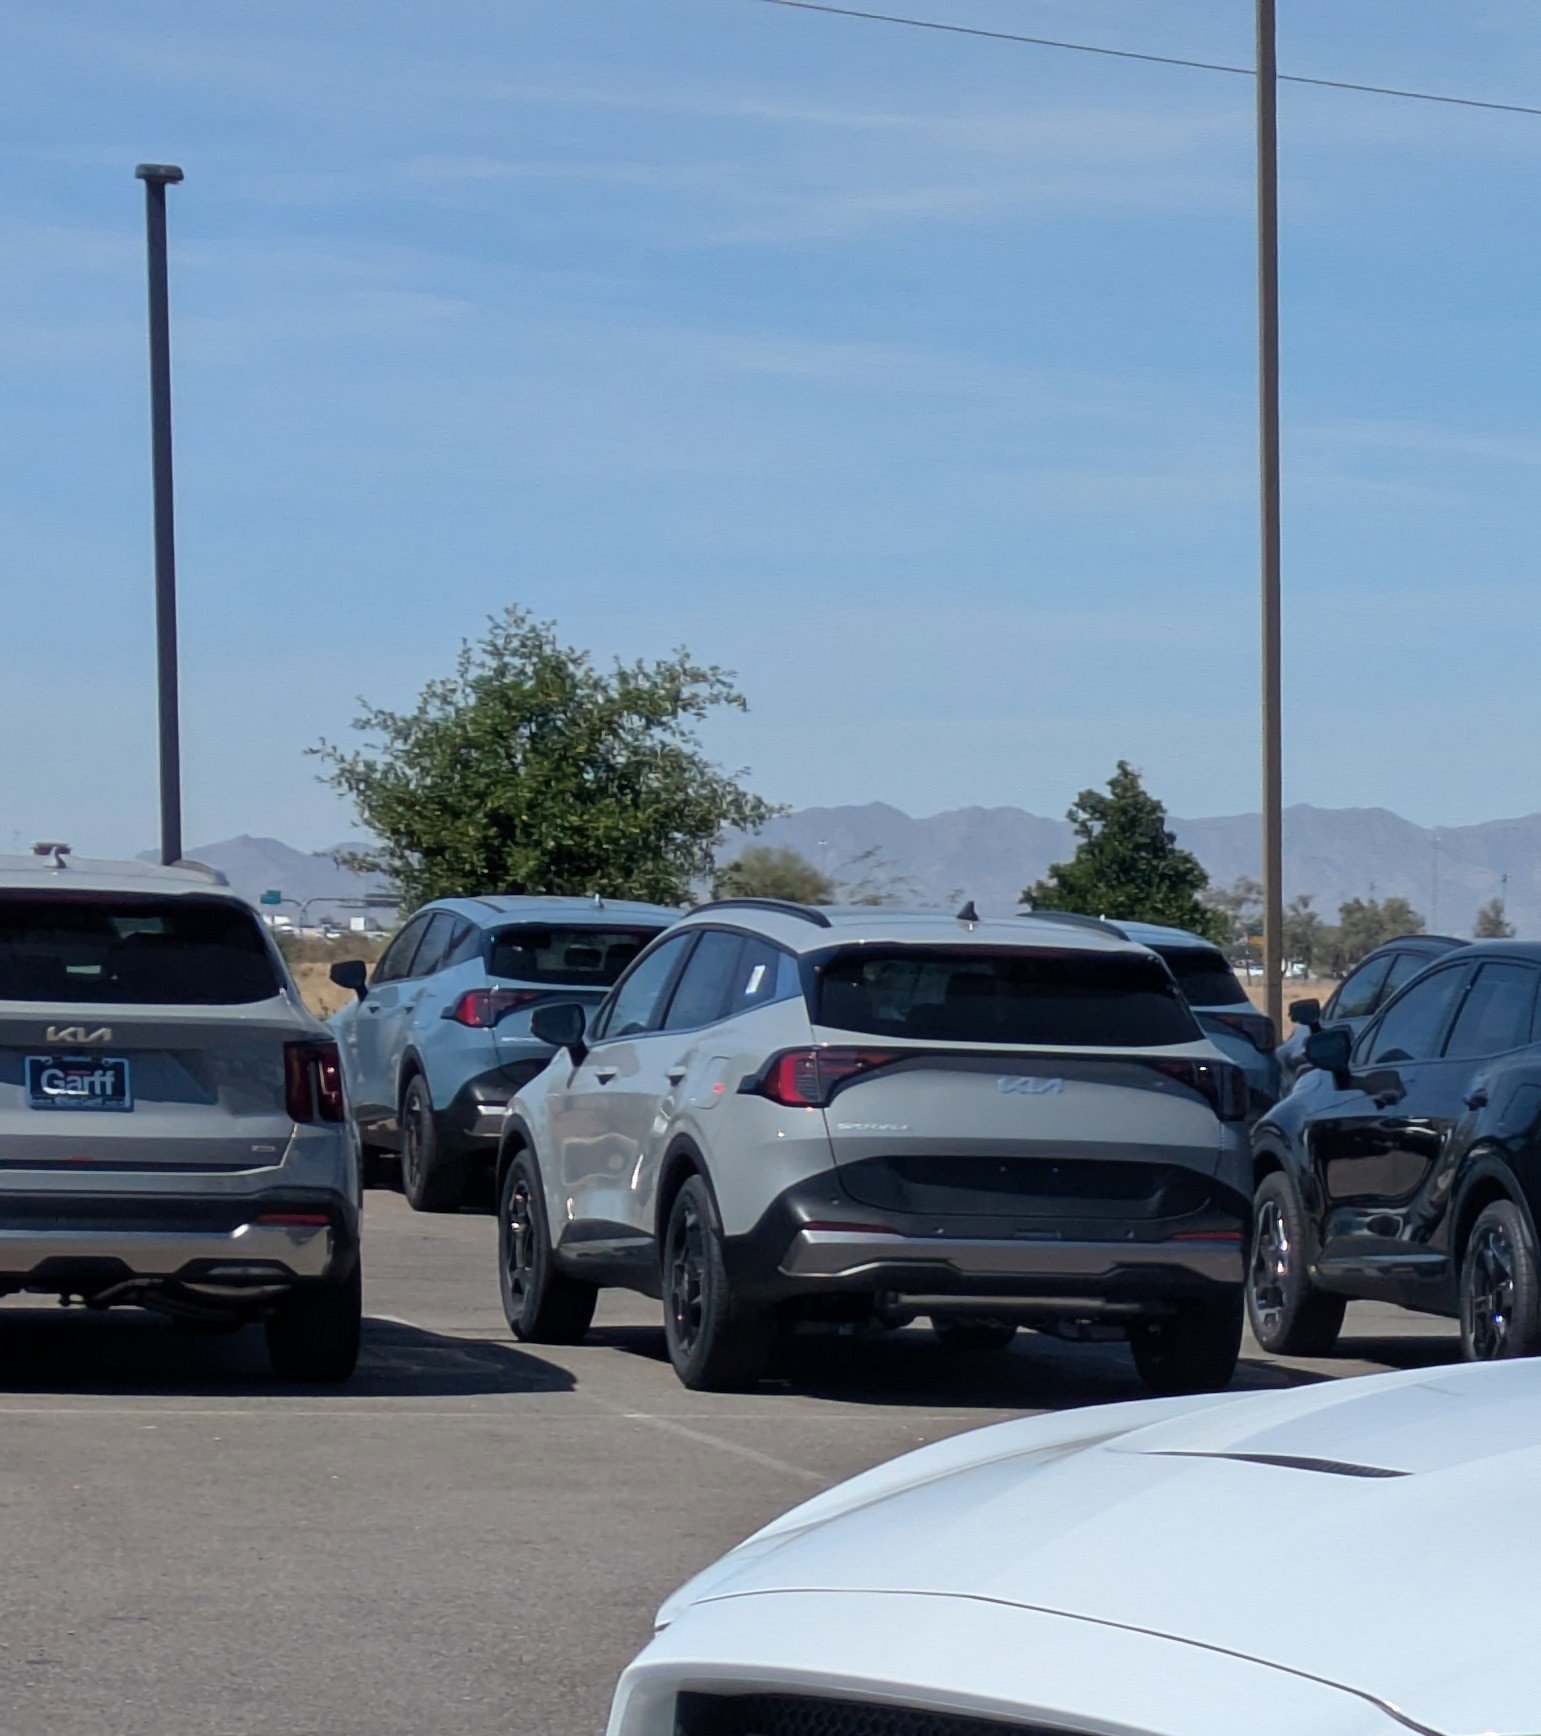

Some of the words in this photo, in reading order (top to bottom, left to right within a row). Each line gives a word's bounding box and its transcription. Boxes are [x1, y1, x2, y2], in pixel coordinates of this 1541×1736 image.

[46, 1026, 112, 1042] KIA
[40, 1068, 115, 1095] Garff
[997, 1077, 1064, 1095] KIA
